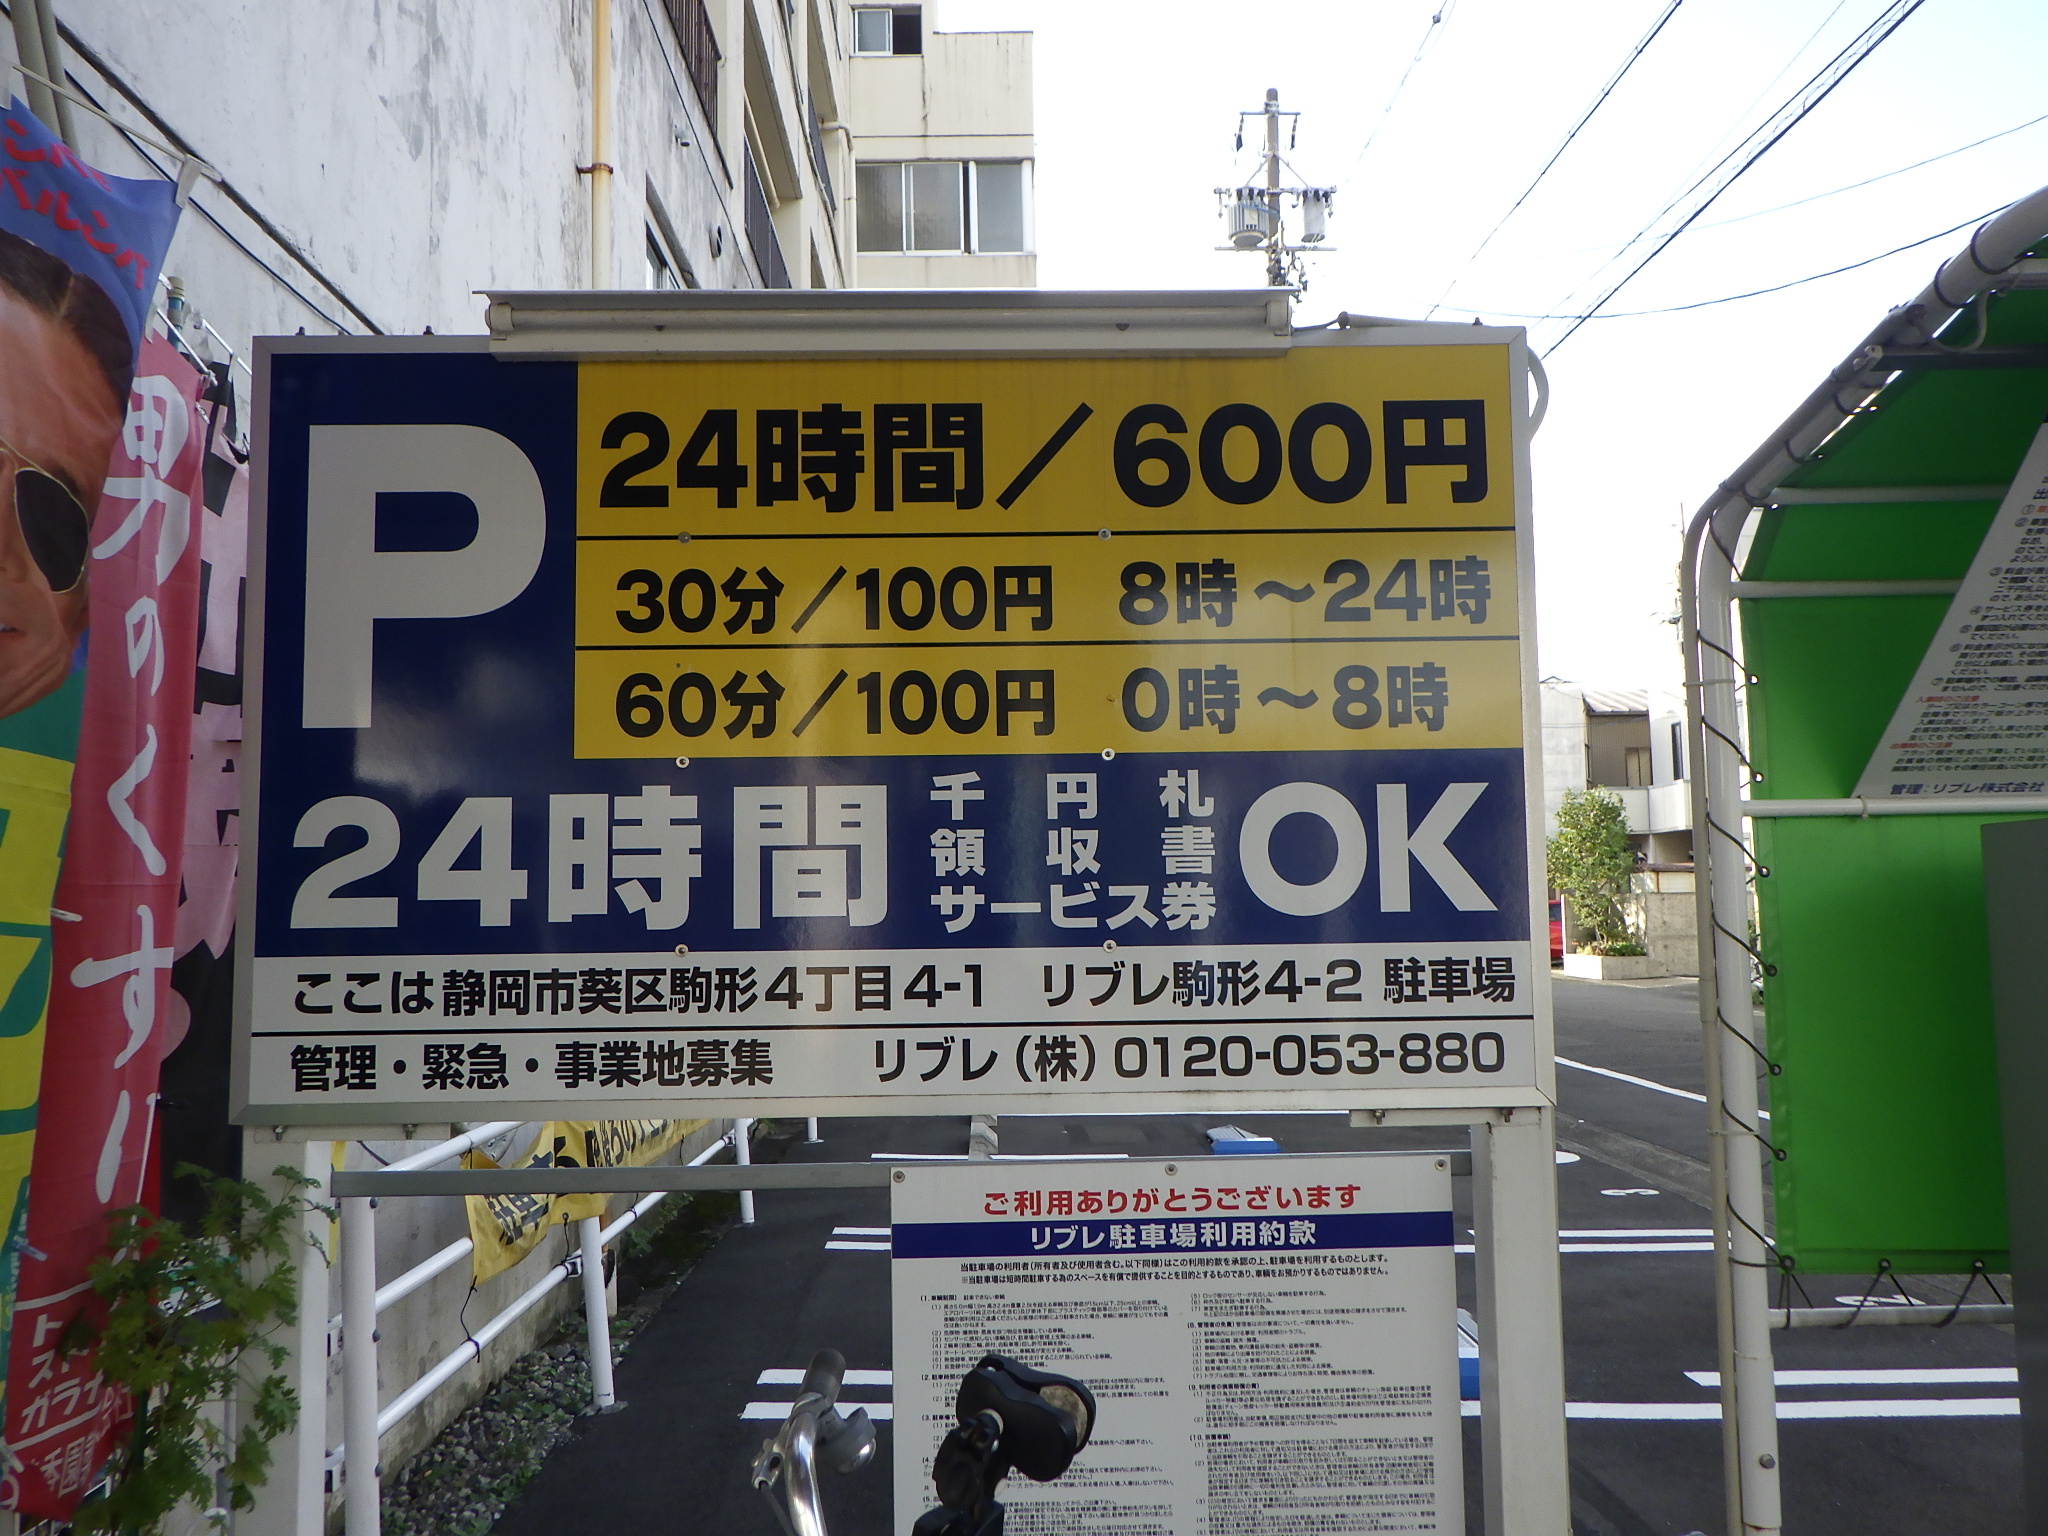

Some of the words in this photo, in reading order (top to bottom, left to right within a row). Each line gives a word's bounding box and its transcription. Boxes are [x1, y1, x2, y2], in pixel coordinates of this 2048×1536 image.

[600, 400, 1488, 513] 24時間/600円
[303, 424, 546, 729] P
[616, 565, 1054, 637] 30分/100円
[616, 668, 1054, 740] 60分/100円
[291, 784, 889, 932] 24時間
[1239, 780, 1497, 918] OK
[930, 881, 1217, 933] サービス券
[294, 964, 983, 1017] ここは静岡市葵区駒形4丁目4-1
[1042, 959, 1362, 1007] リブレ駒形4-2
[1383, 956, 1517, 1004] 駐車場
[290, 1039, 774, 1092] 管理・緊急・事業地募集
[983, 1184, 1362, 1217] ご利用ありがとうございます
[1030, 1220, 1317, 1250] リブレ駐車場利用約款
